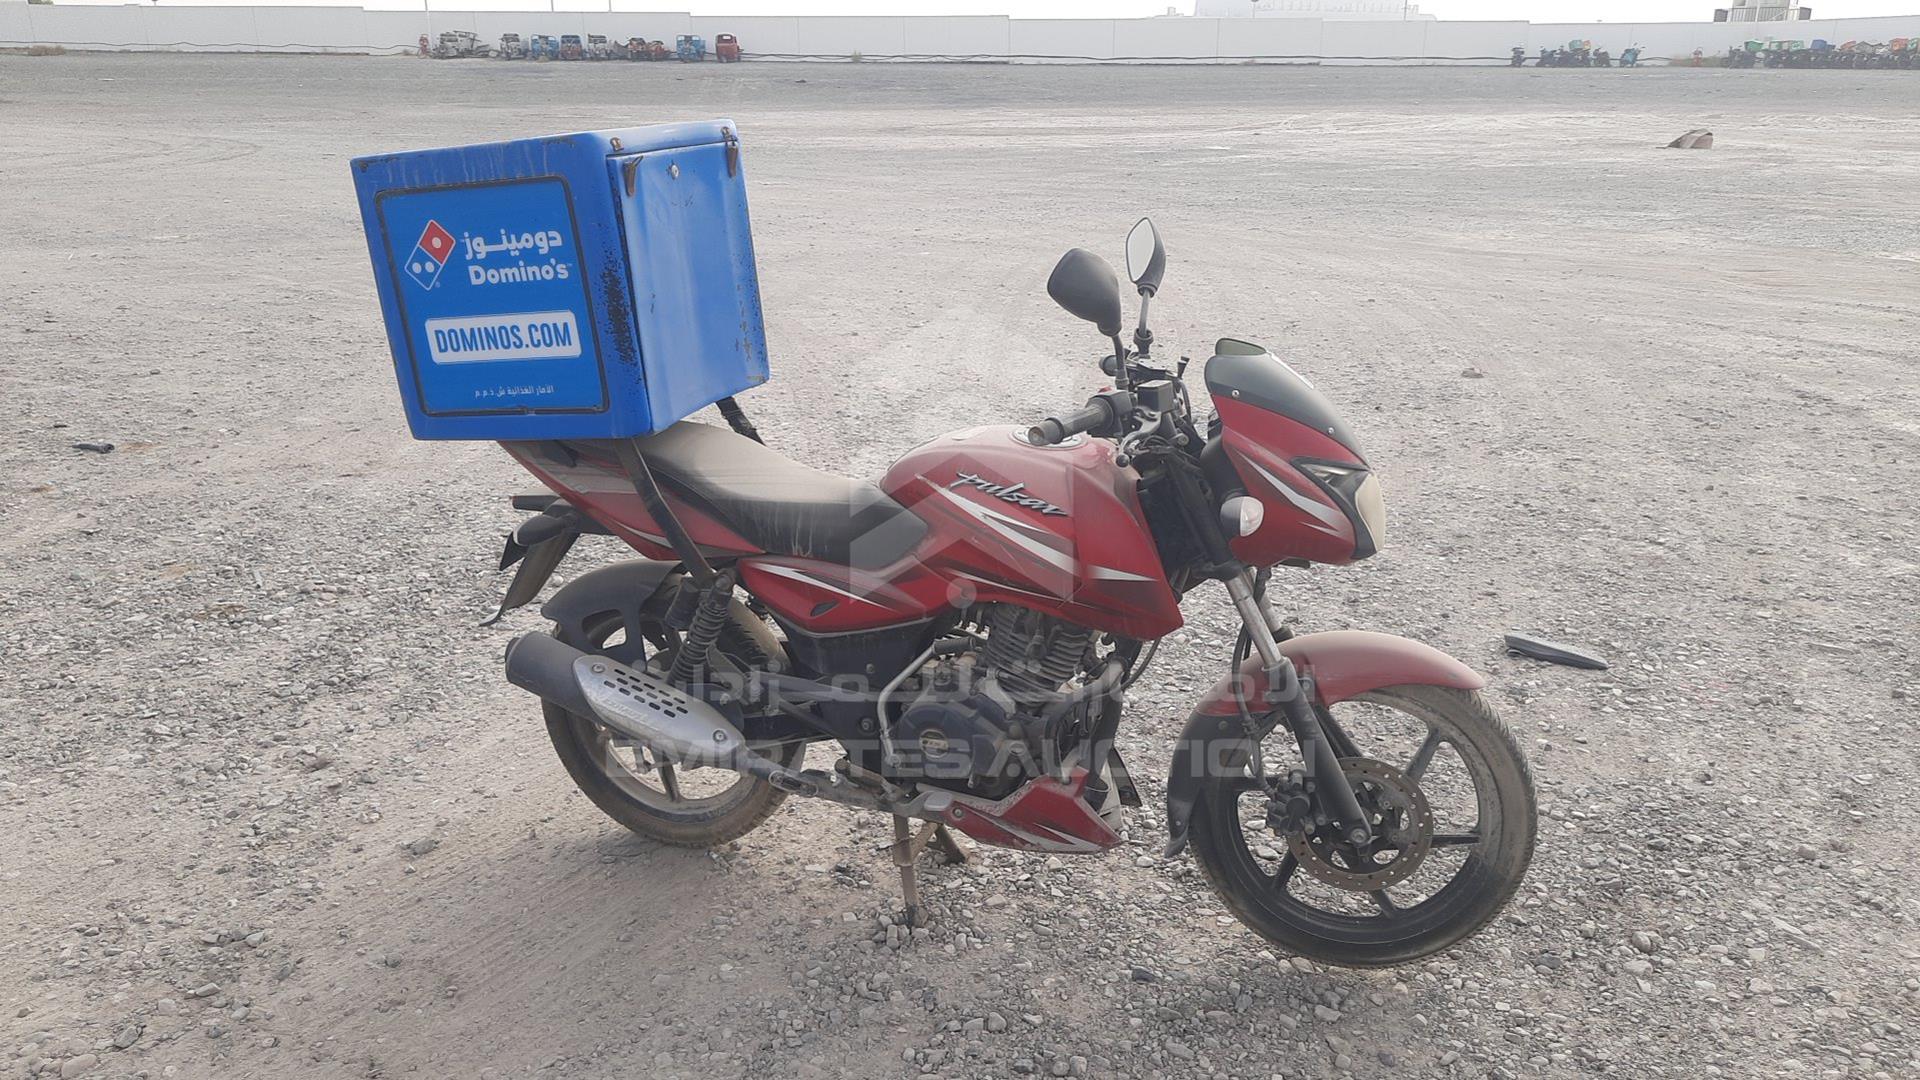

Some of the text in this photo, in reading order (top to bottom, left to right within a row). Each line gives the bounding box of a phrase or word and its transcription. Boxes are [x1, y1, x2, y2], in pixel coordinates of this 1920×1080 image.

[463, 228, 564, 261] دومينوز
[467, 258, 569, 286] Domino's
[434, 321, 572, 354] DOMINOS.COM
